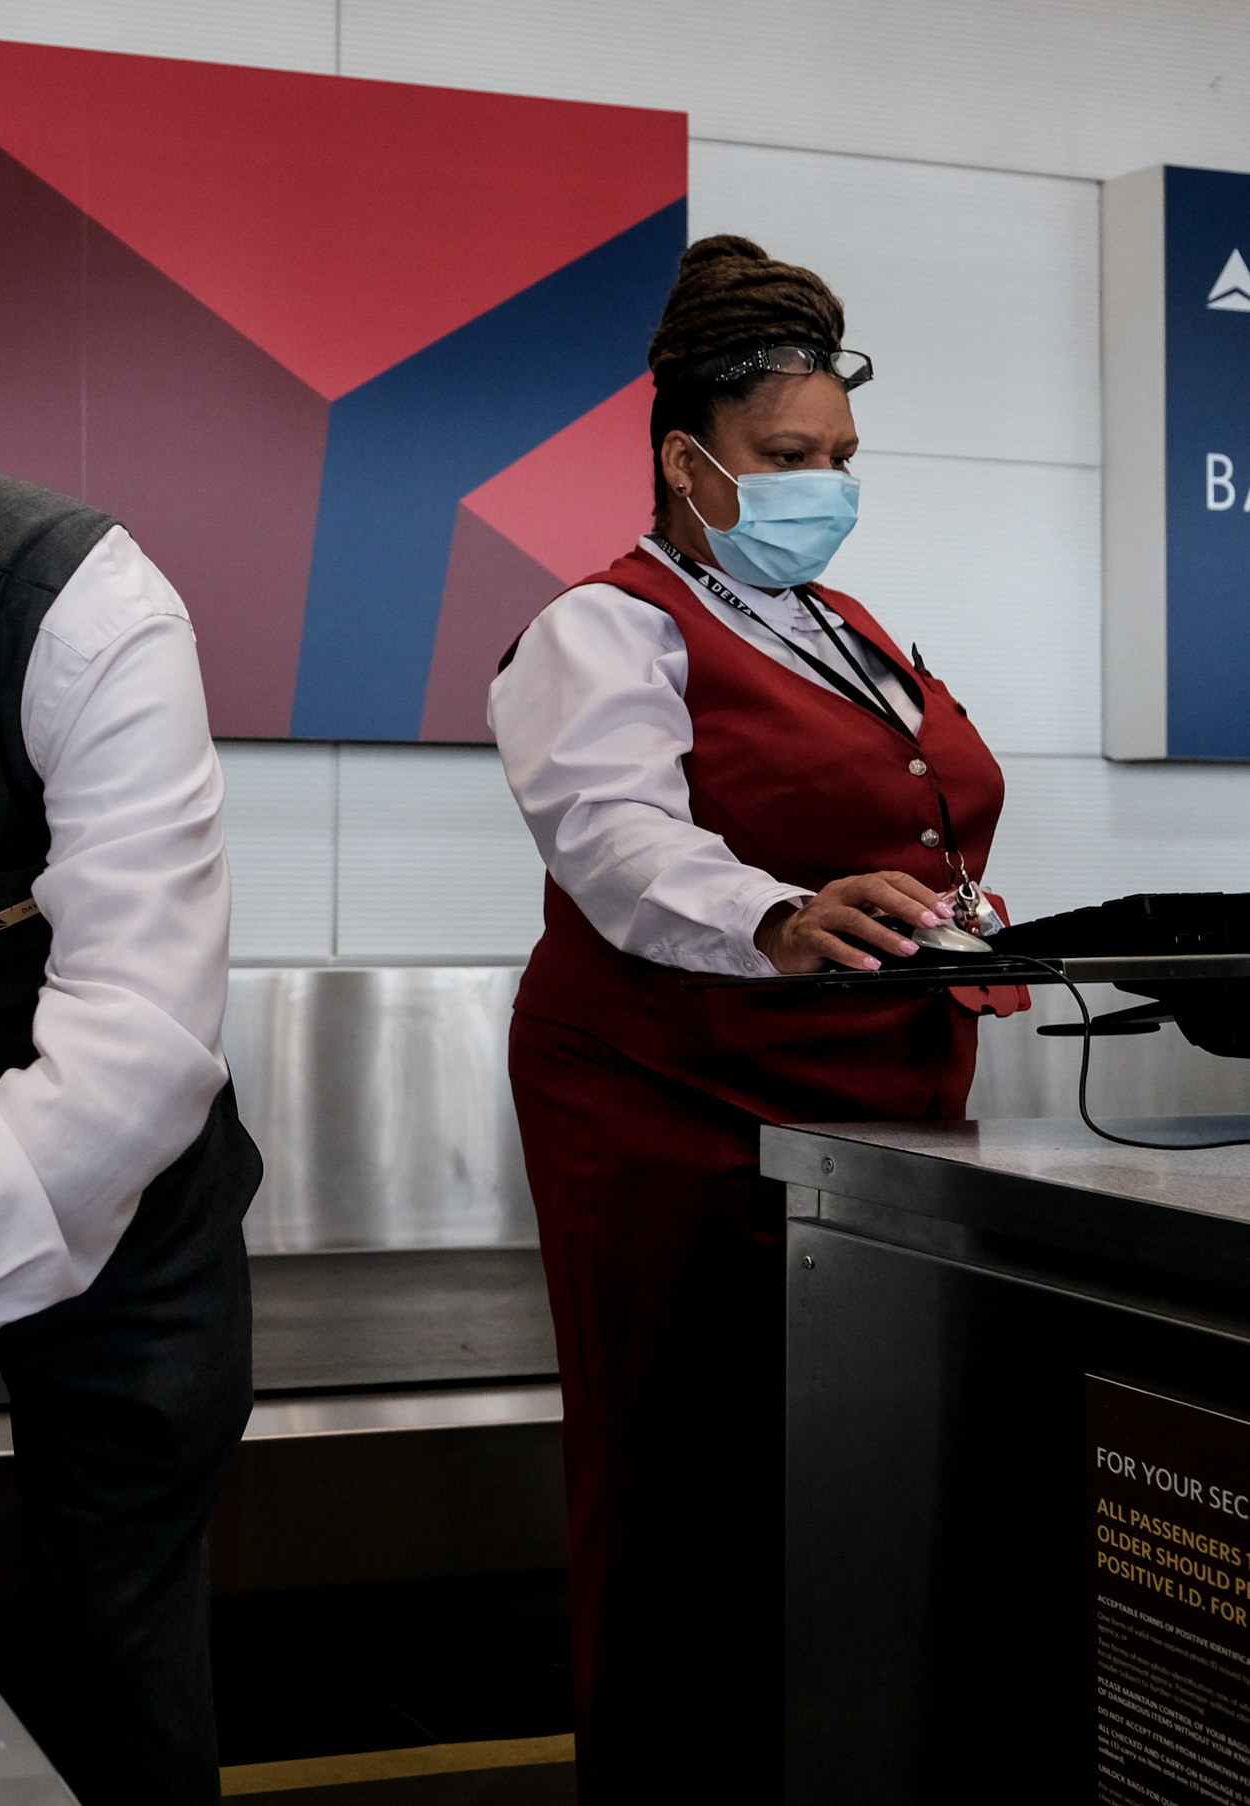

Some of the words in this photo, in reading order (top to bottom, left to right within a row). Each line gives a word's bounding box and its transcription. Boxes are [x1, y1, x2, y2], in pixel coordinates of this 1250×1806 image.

[1206, 453, 1250, 513] B
[711, 582, 752, 615] DELTA
[1097, 1446, 1137, 1480] FOR
[1141, 1461, 1204, 1504] YOUR
[1209, 1485, 1250, 1520] SEC
[1097, 1498, 1126, 1524] ALL
[1130, 1508, 1242, 1567] PASSENGERS
[1097, 1525, 1152, 1561] OLDER
[1156, 1546, 1230, 1590] SHOULD
[1097, 1550, 1175, 1598] POSITIVE
[1179, 1583, 1206, 1611] I.D.
[1211, 1596, 1248, 1628] FOR
[1165, 1623, 1174, 1632] OF
[1176, 1627, 1208, 1648] POSITIVE
[1098, 1676, 1121, 1693] PLEASE
[1122, 1687, 1157, 1709] MAINTAIN
[1159, 1705, 1192, 1727] CONTROL
[1194, 1722, 1203, 1731] OF
[1205, 1727, 1226, 1742] YOUR
[1098, 1687, 1106, 1695] OF
[1108, 1691, 1150, 1718] DANGEROUS
[1151, 1712, 1173, 1728] ITEMS
[1174, 1723, 1212, 1745] WITHOUT
[1211, 1741, 1232, 1756] YOUR
[1098, 1706, 1110, 1716] DO
[1110, 1711, 1124, 1723] NOT
[1125, 1719, 1151, 1737] ACCEPT
[1153, 1732, 1174, 1749] ITEMS
[1176, 1744, 1196, 1760] FROM
[1144, 1746, 1161, 1759] AND
